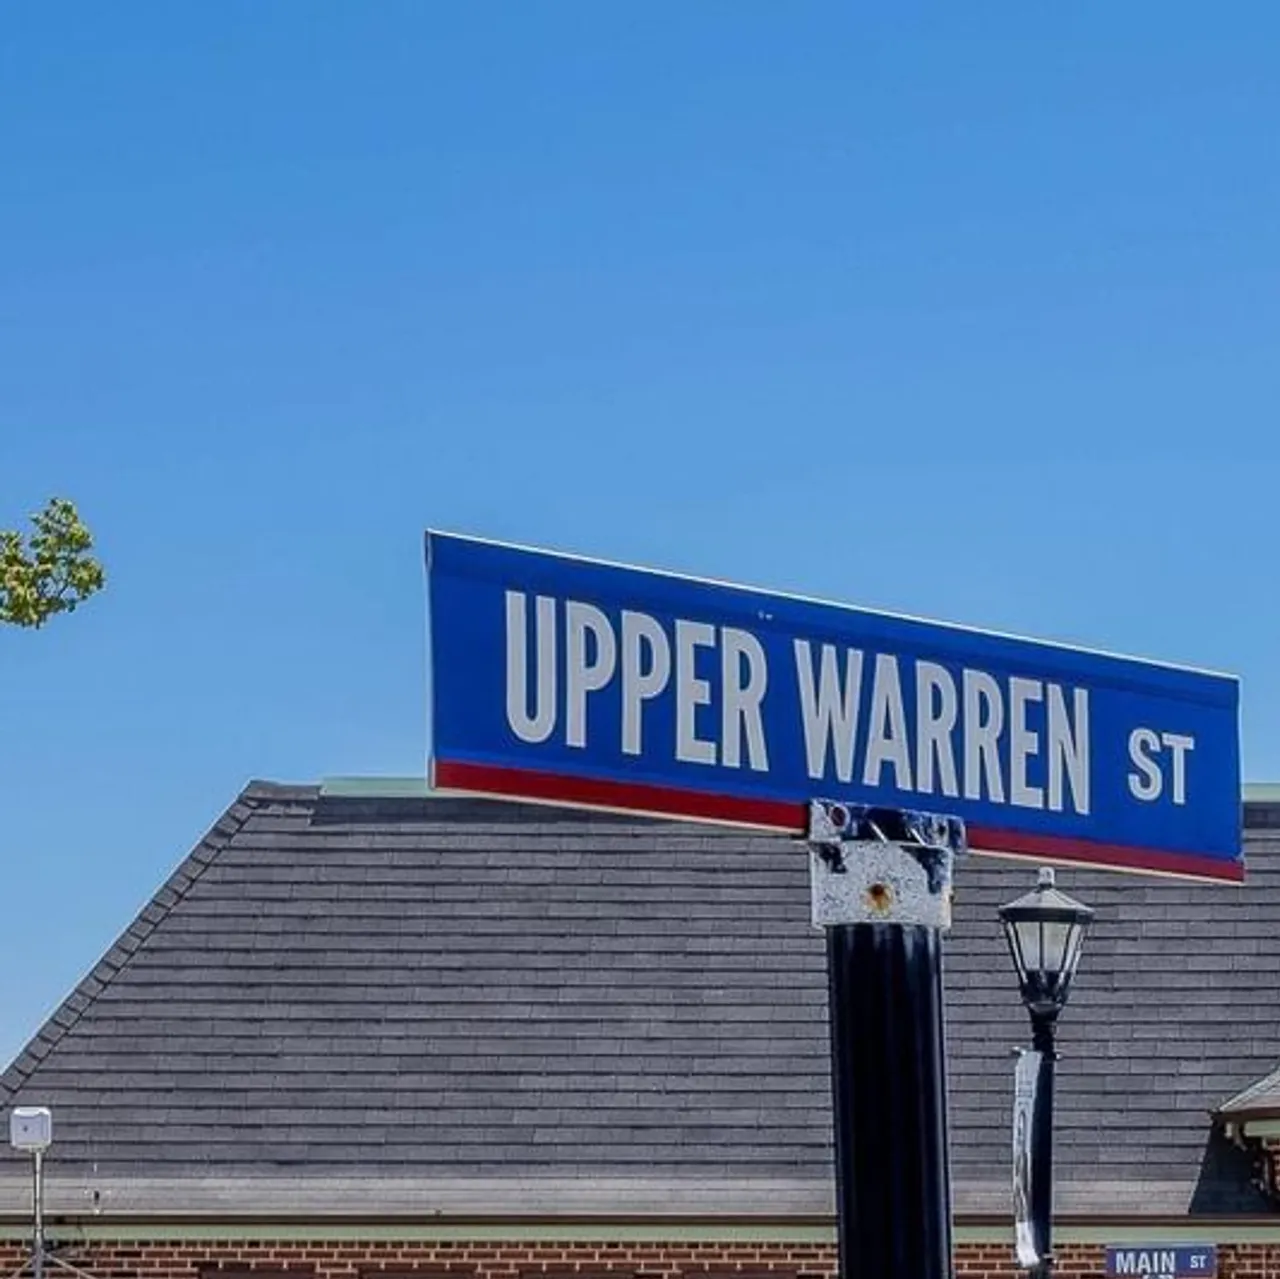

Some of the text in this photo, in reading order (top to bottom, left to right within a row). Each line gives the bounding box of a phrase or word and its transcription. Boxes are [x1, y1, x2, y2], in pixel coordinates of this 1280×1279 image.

[505, 589, 1195, 816] UPPER WARREN ST
[1115, 1251, 1208, 1274] MAIN ST
